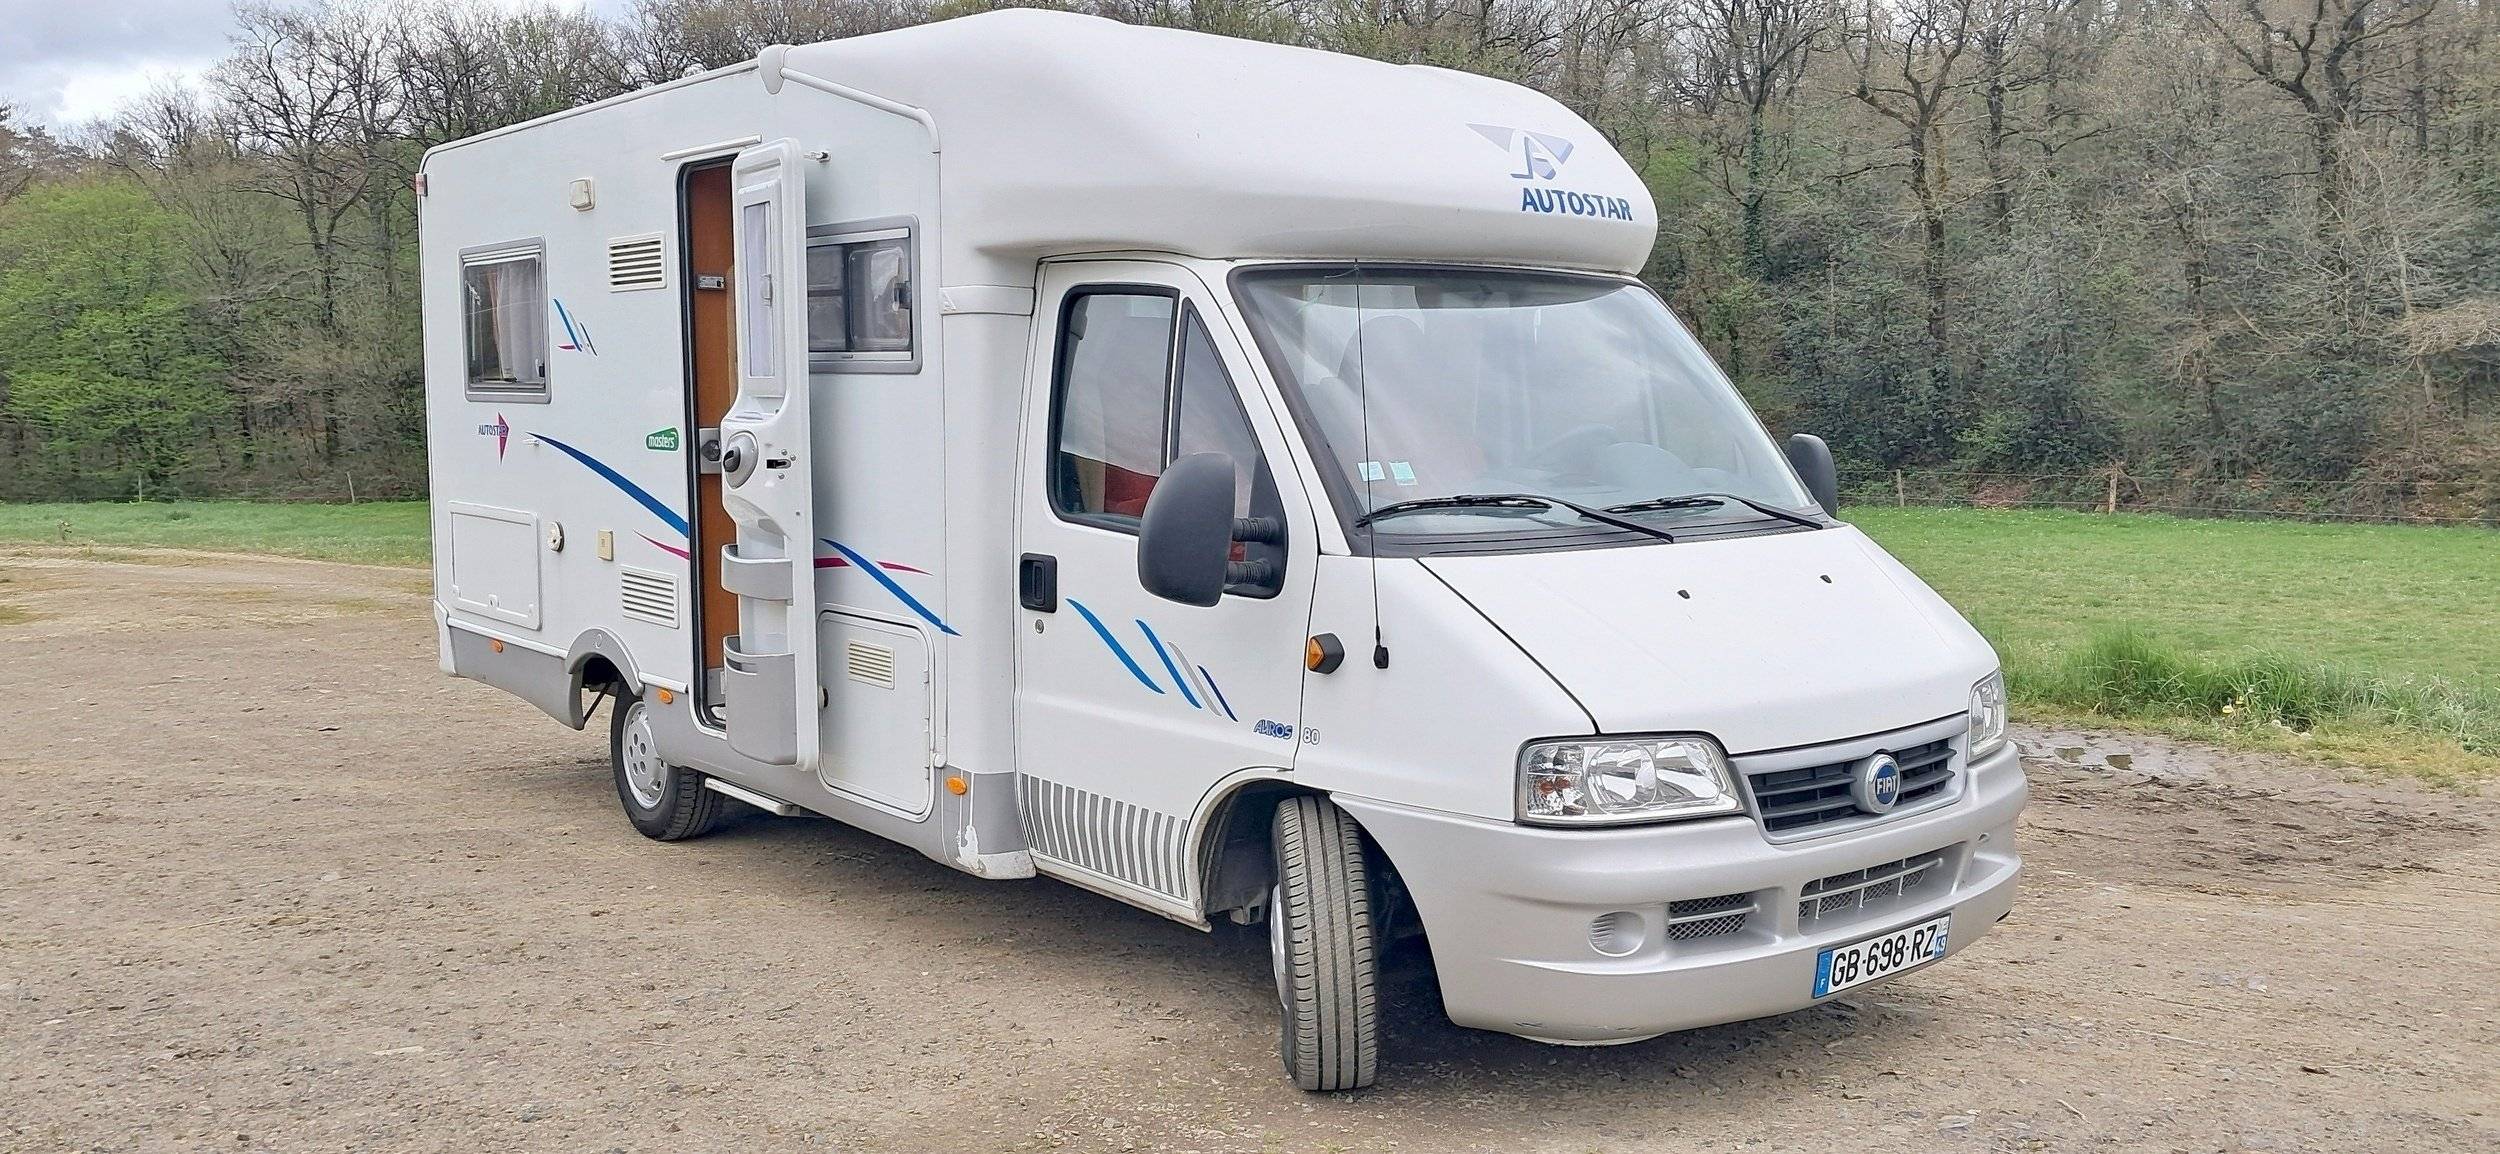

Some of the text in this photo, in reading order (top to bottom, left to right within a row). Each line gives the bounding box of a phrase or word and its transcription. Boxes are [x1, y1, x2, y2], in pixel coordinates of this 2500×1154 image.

[1521, 187, 1633, 221] AUTOSTAR
[648, 434, 675, 449] masters
[1303, 727, 1320, 745] 80
[1876, 775, 1897, 795] FIAT
[1819, 978, 1825, 989] F
[1935, 936, 1947, 953] 49
